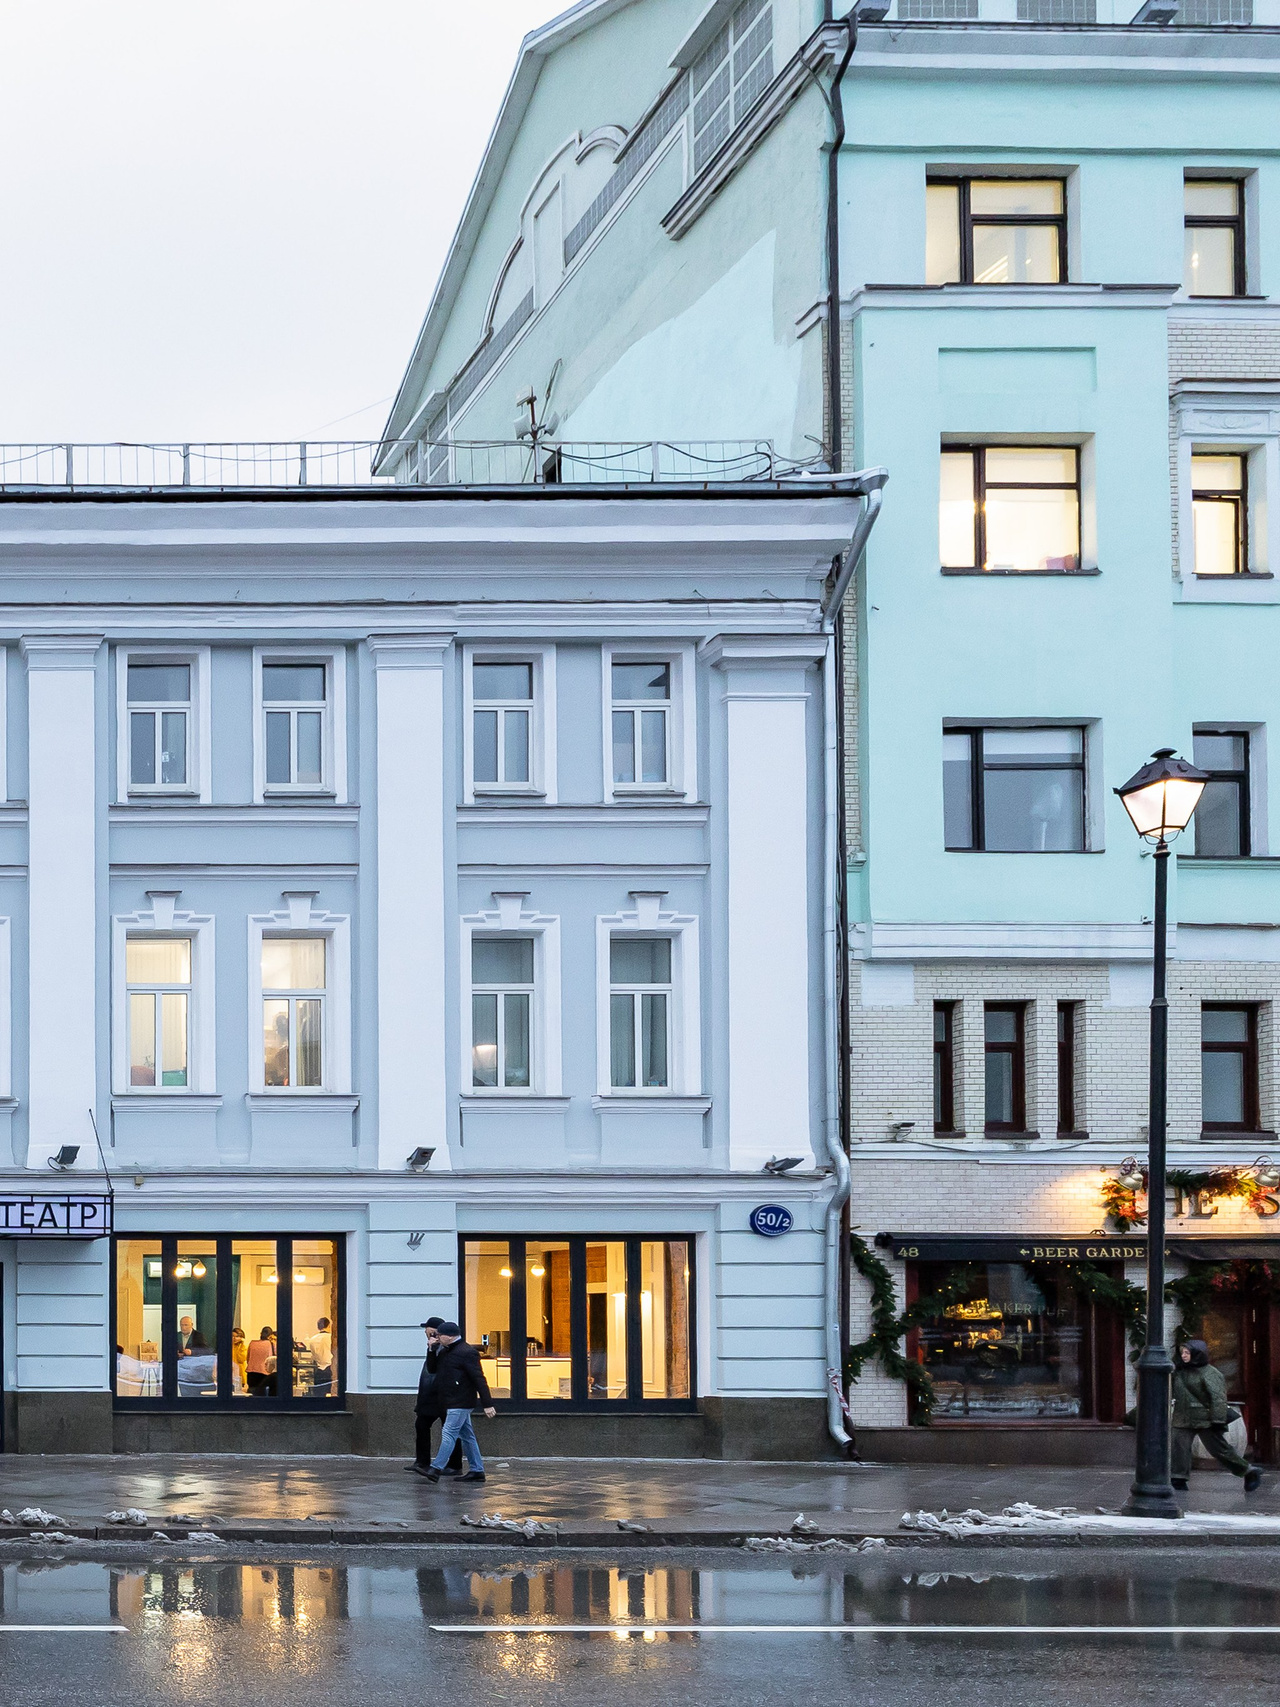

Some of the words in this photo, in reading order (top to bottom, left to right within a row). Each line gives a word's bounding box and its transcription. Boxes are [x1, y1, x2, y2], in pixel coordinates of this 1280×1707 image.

[757, 1212, 790, 1227] 50/2
[898, 1247, 919, 1257] 48
[1033, 1247, 1080, 1258] BEER
[1086, 1247, 1147, 1258] GARDE
